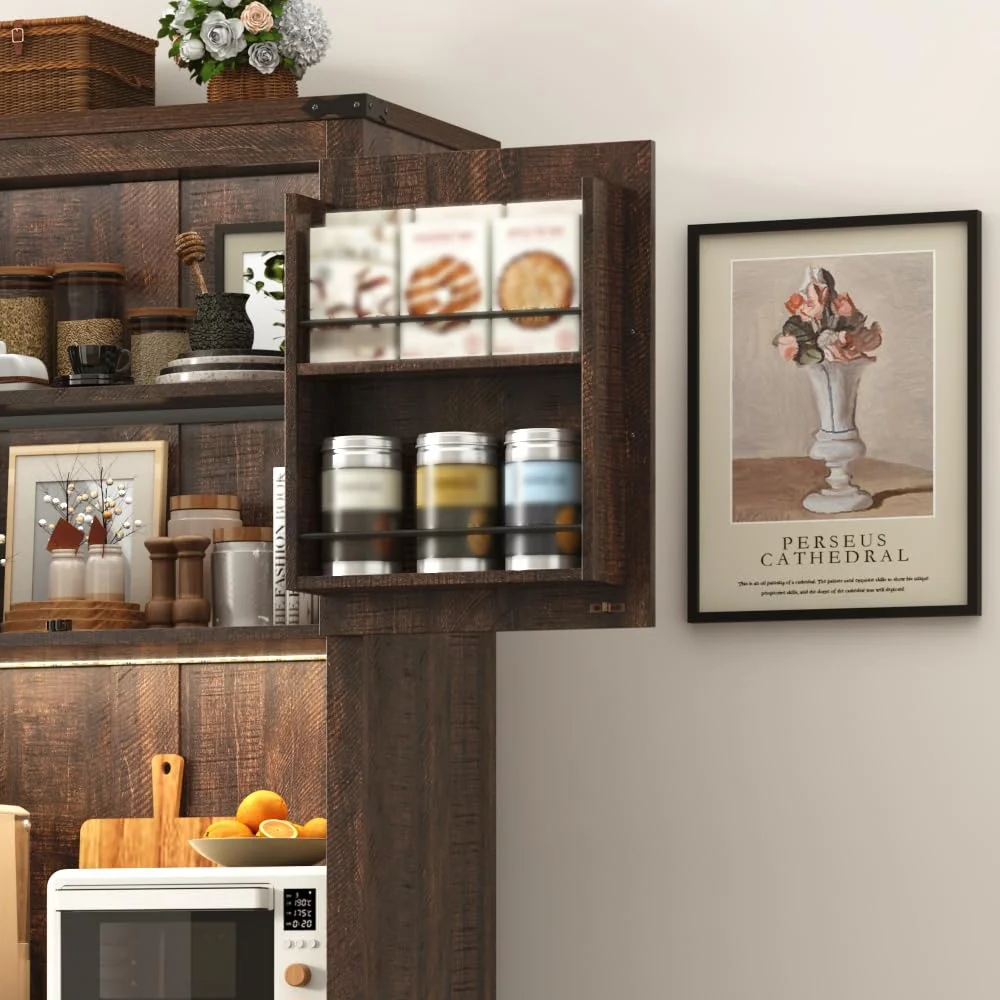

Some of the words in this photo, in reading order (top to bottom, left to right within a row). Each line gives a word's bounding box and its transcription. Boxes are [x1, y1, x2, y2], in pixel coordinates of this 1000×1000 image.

[275, 472, 286, 520] BOOK
[760, 548, 910, 567] CATHEDRAL
[782, 533, 887, 551] PERSEUS
[275, 525, 286, 597] FASHION
